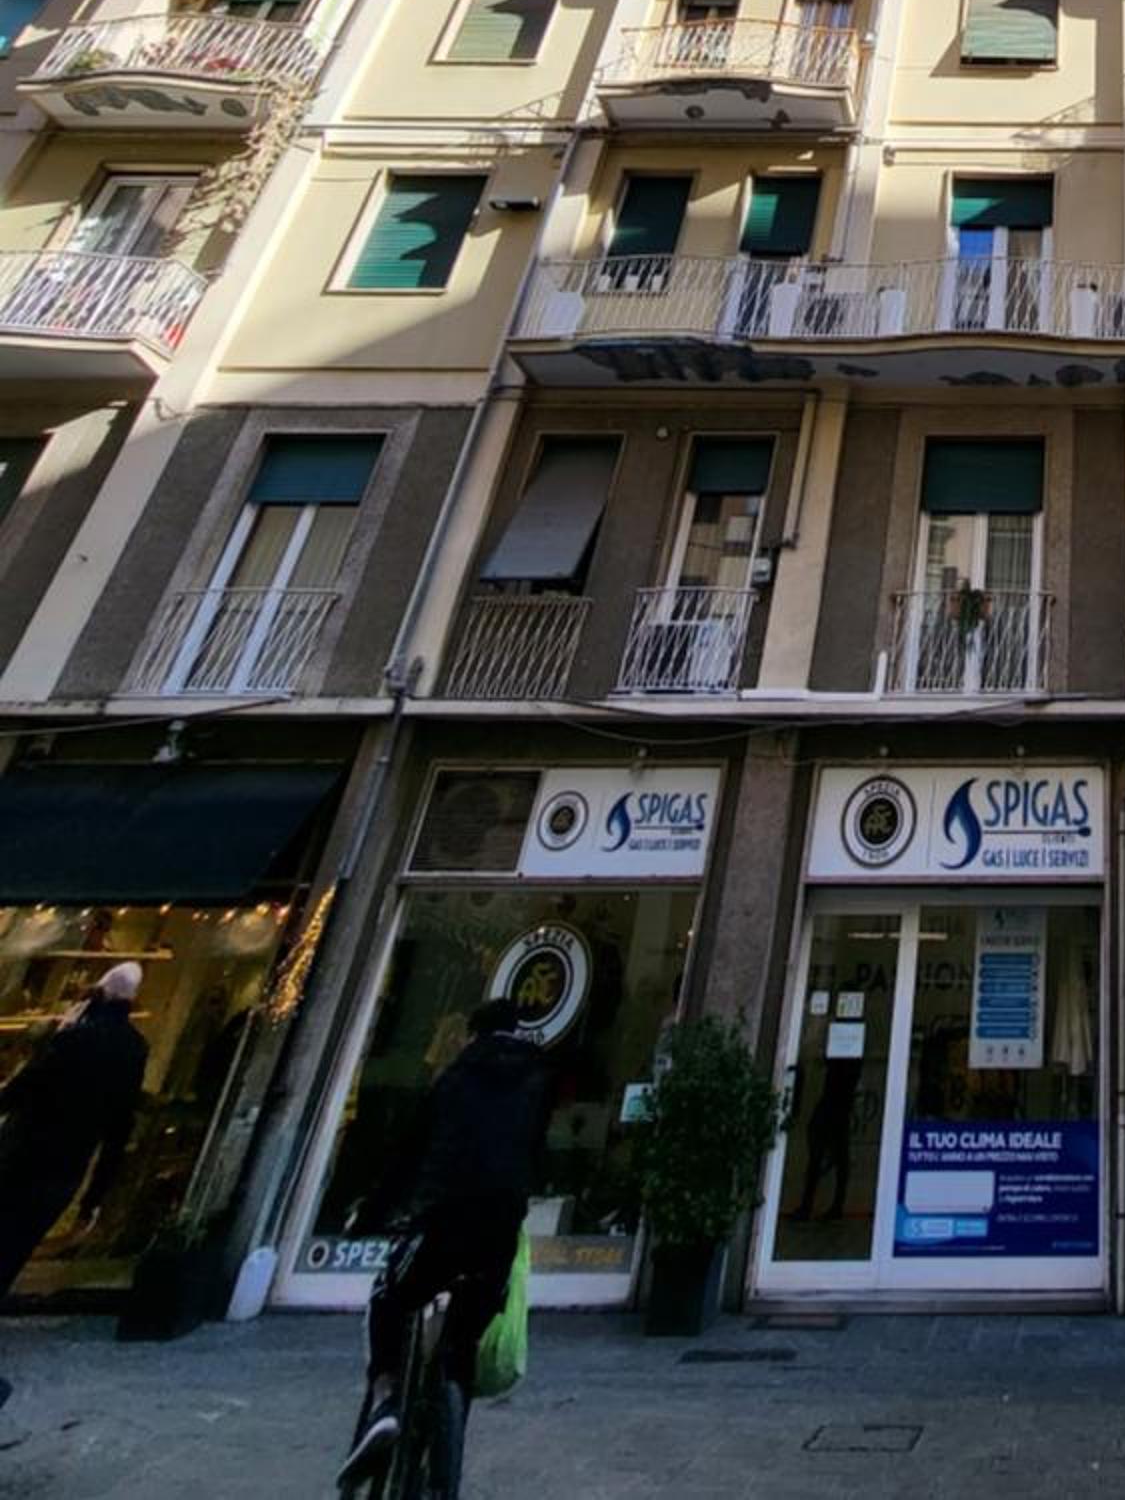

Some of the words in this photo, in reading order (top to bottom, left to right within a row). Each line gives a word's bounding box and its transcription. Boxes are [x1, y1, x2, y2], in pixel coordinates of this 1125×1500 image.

[634, 793, 708, 824] SPIGAS
[983, 779, 1090, 827] SPIGAS
[982, 849, 1003, 868] GAS
[1012, 849, 1039, 868] LUCE
[1048, 849, 1089, 868] SERVIZI
[908, 1132, 923, 1149] IL
[926, 1132, 957, 1149] TUO
[960, 1132, 1005, 1149] CLIMA
[1009, 1132, 1062, 1149] IDEALE
[333, 1241, 391, 1267] SPEZ
